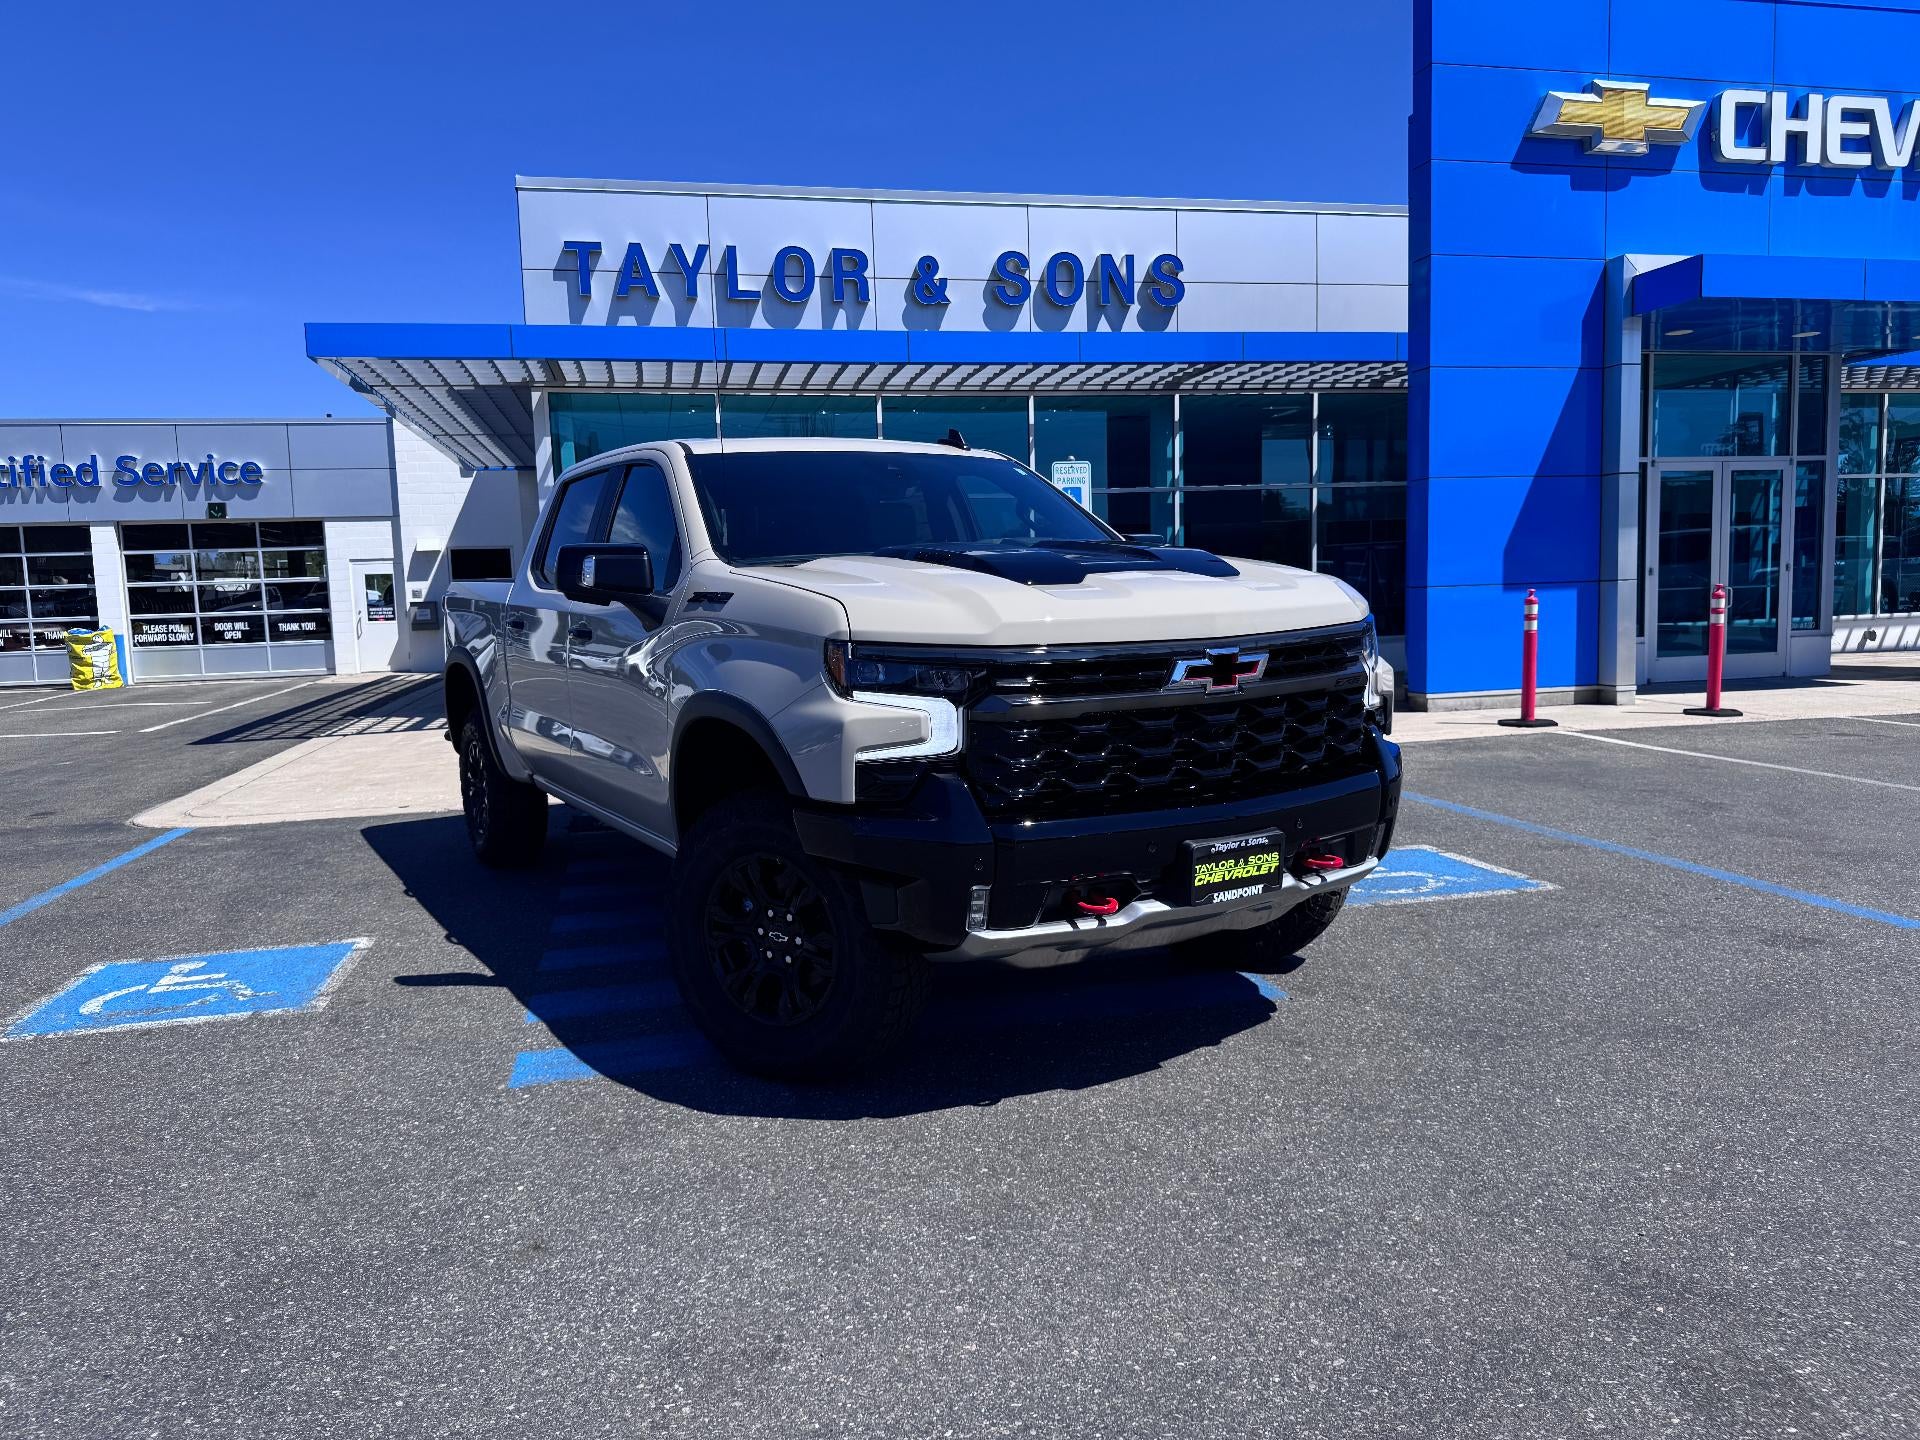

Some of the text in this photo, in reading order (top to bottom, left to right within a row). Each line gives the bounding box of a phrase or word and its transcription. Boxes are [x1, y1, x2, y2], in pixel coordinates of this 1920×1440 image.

[1720, 89, 1920, 167] CHEV
[563, 240, 1187, 308] TAYLOR & SONS
[115, 453, 264, 487] Service
[1055, 466, 1087, 475] RESERVED
[1056, 476, 1086, 485] PARKING
[143, 624, 186, 634] PLEASE PULL
[214, 622, 250, 631] DOOR WILL
[278, 622, 317, 632] THANK YOU!
[134, 632, 195, 642] FORWARD SLOWLY
[224, 631, 242, 640] OPEN
[1214, 842, 1240, 852] Taylor
[1247, 837, 1266, 846] Sons
[1195, 852, 1280, 873] TAYLOR & SONS
[1194, 863, 1279, 886] CHEVROLET
[1212, 884, 1265, 903] SANDPOINT
